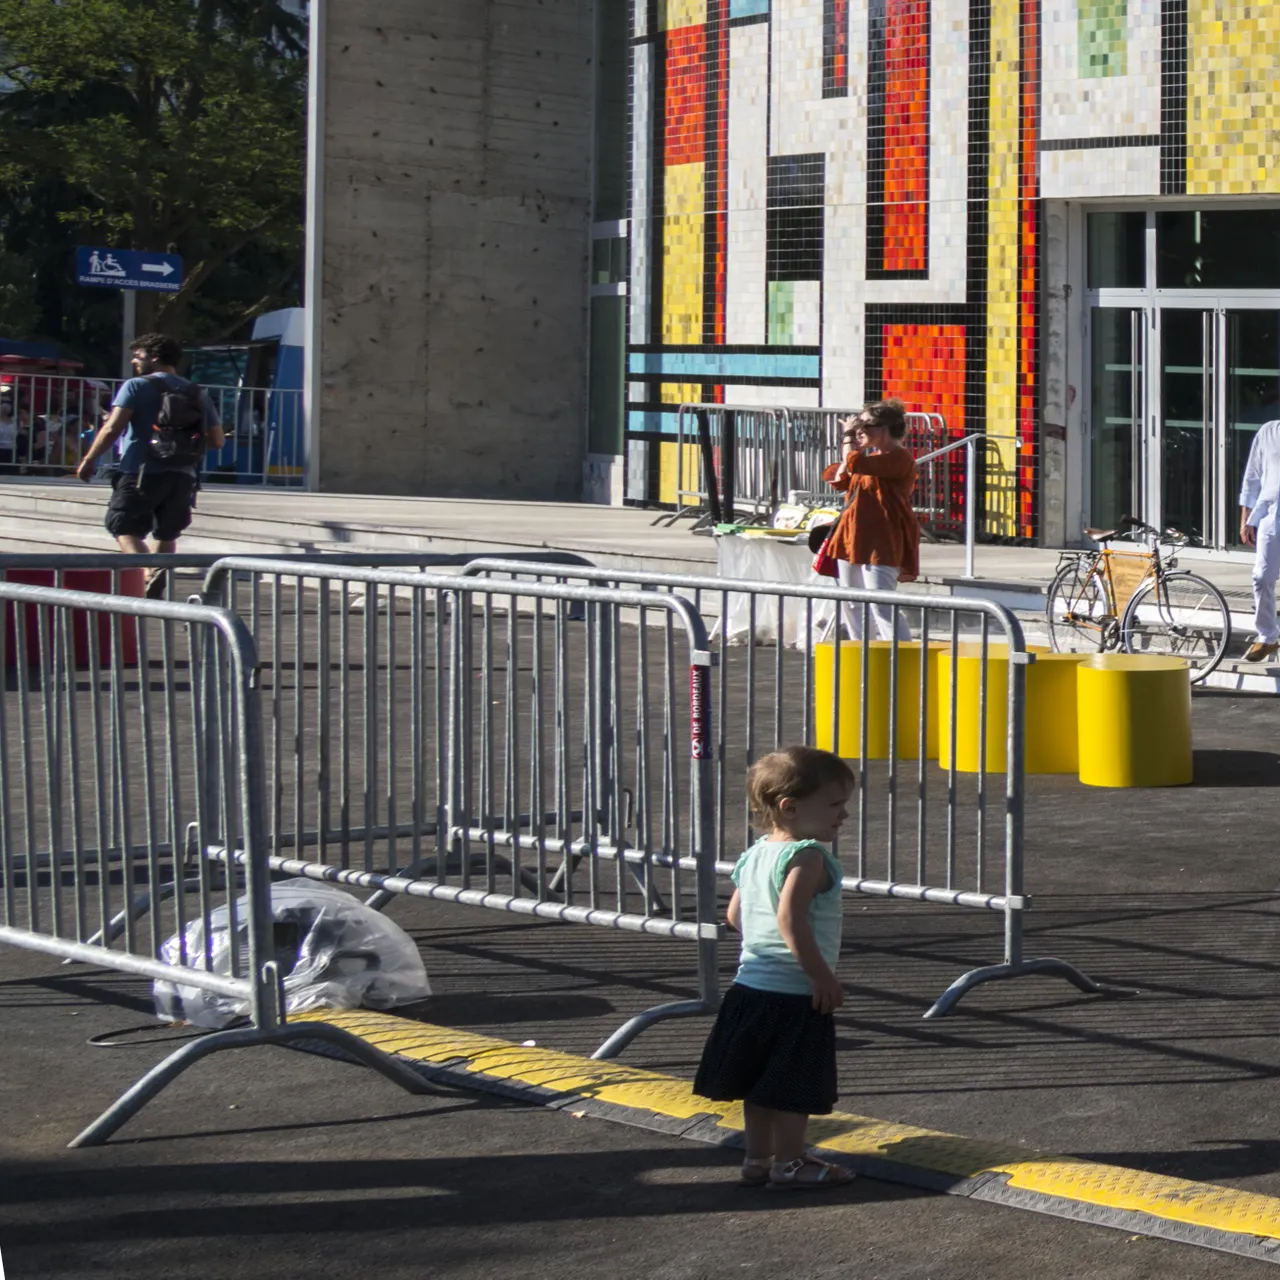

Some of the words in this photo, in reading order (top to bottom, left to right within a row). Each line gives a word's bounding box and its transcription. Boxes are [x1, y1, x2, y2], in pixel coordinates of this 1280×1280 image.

[79, 275, 105, 284] RAMPE
[139, 280, 181, 290] BRASSERIE
[692, 670, 701, 719] BORDEAUX
[692, 721, 701, 734] DE
